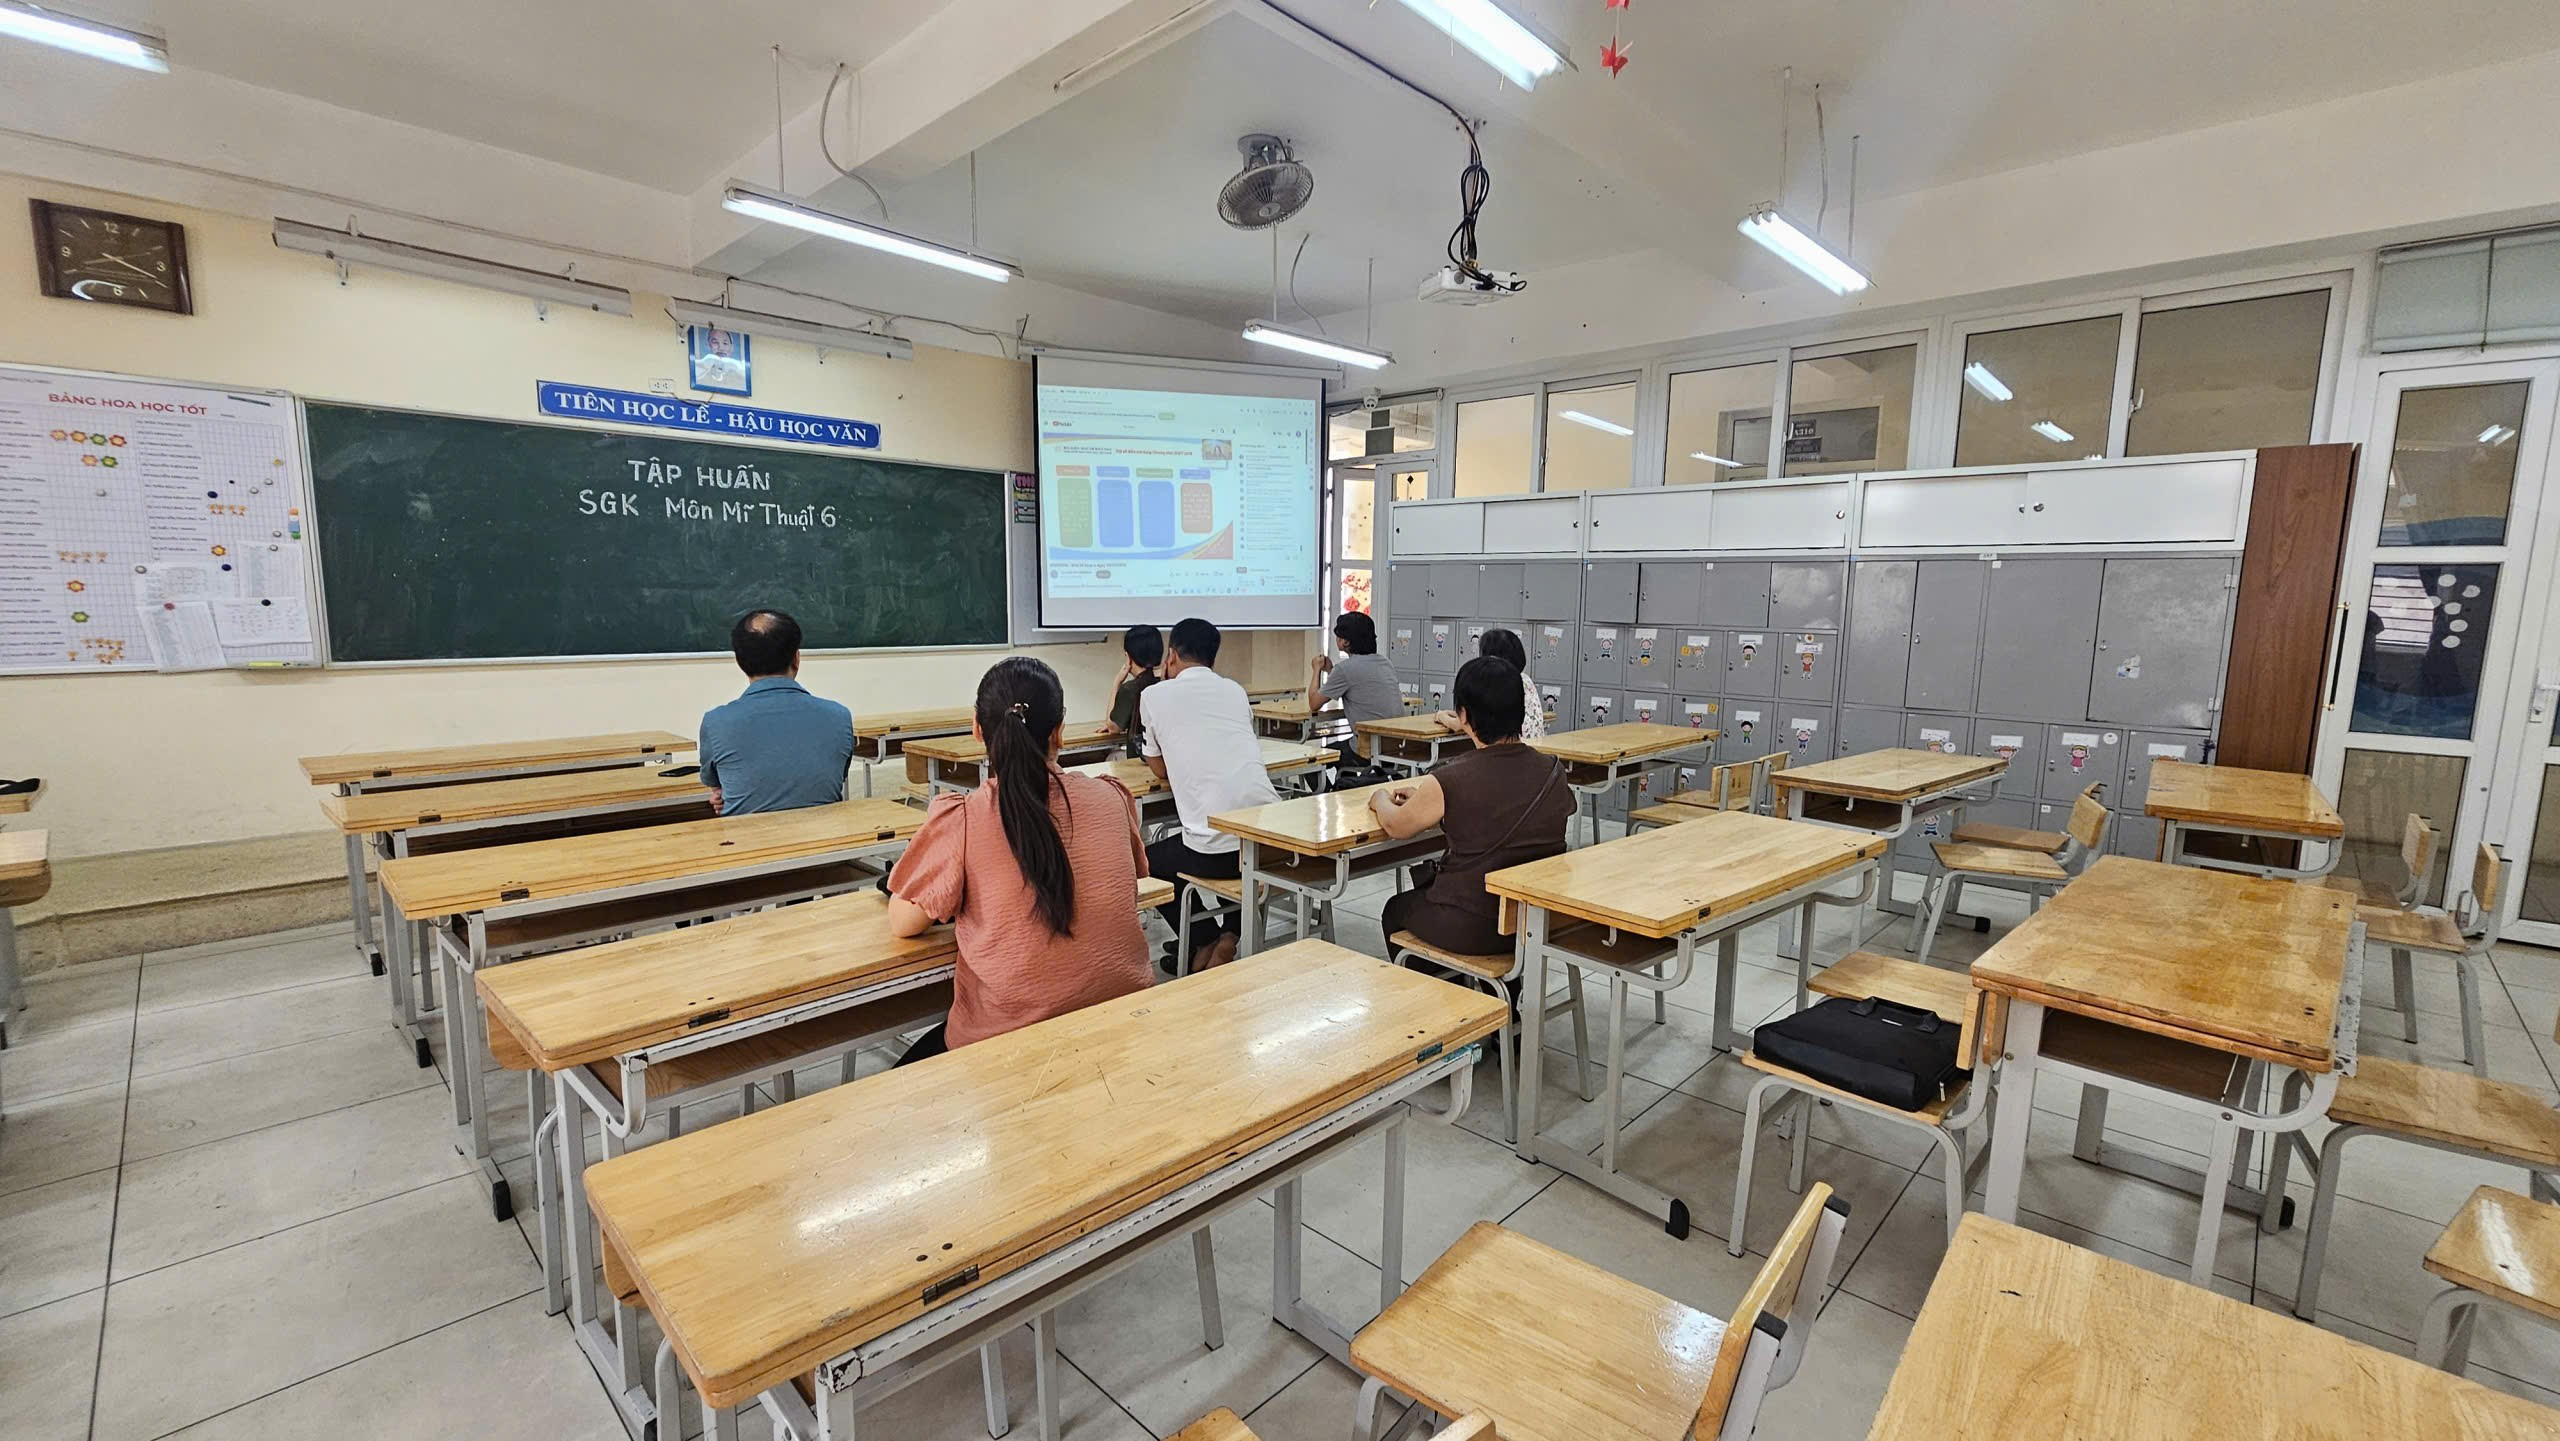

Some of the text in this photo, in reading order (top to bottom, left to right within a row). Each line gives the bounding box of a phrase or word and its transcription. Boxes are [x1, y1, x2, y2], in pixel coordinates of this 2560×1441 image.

[103, 221, 120, 234] 12
[60, 245, 72, 258] 9
[155, 260, 166, 272] 3
[112, 285, 124, 297] 6
[48, 392, 97, 406] BẢNG
[101, 399, 137, 410] HOA
[141, 402, 175, 412] HỌC
[178, 403, 208, 416] TỐT
[554, 391, 616, 414] TIÊN
[618, 400, 675, 421] HỌC
[727, 411, 774, 433] HẬU
[779, 418, 824, 439] HỌC
[827, 423, 867, 442] VĂN
[627, 456, 770, 491] TẬP HUẤN
[578, 489, 837, 532] SGK Môn Mĩ Thuật 6
